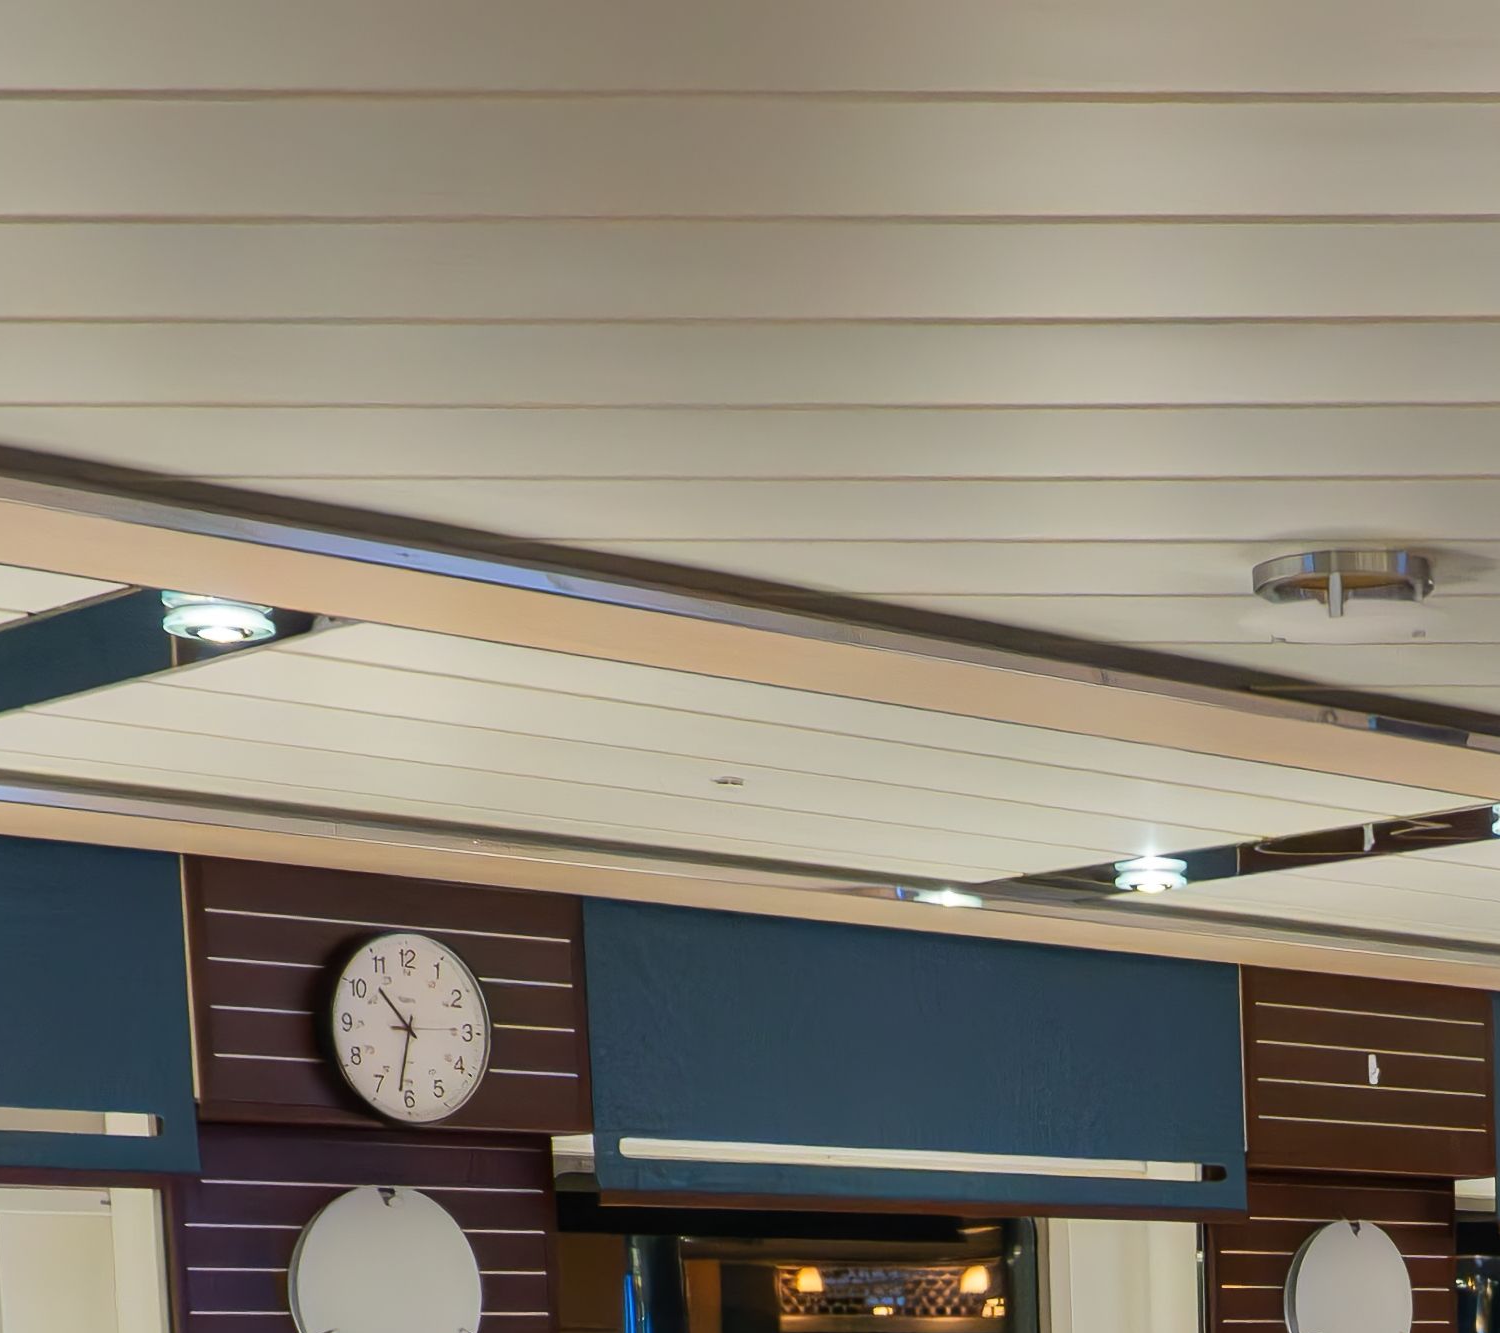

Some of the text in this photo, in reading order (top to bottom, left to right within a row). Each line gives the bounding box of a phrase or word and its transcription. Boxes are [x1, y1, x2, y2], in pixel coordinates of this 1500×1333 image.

[371, 954, 386, 975] 11
[399, 948, 417, 970] 12
[433, 962, 440, 980] 1
[349, 977, 367, 999] 10
[450, 988, 463, 1009] 2
[341, 1011, 354, 1033] 9
[461, 1023, 473, 1043] 3
[350, 1045, 362, 1066] 8
[453, 1055, 465, 1075] 4
[373, 1073, 385, 1094] 7
[432, 1078, 445, 1099] 5
[403, 1089, 416, 1109] 6
